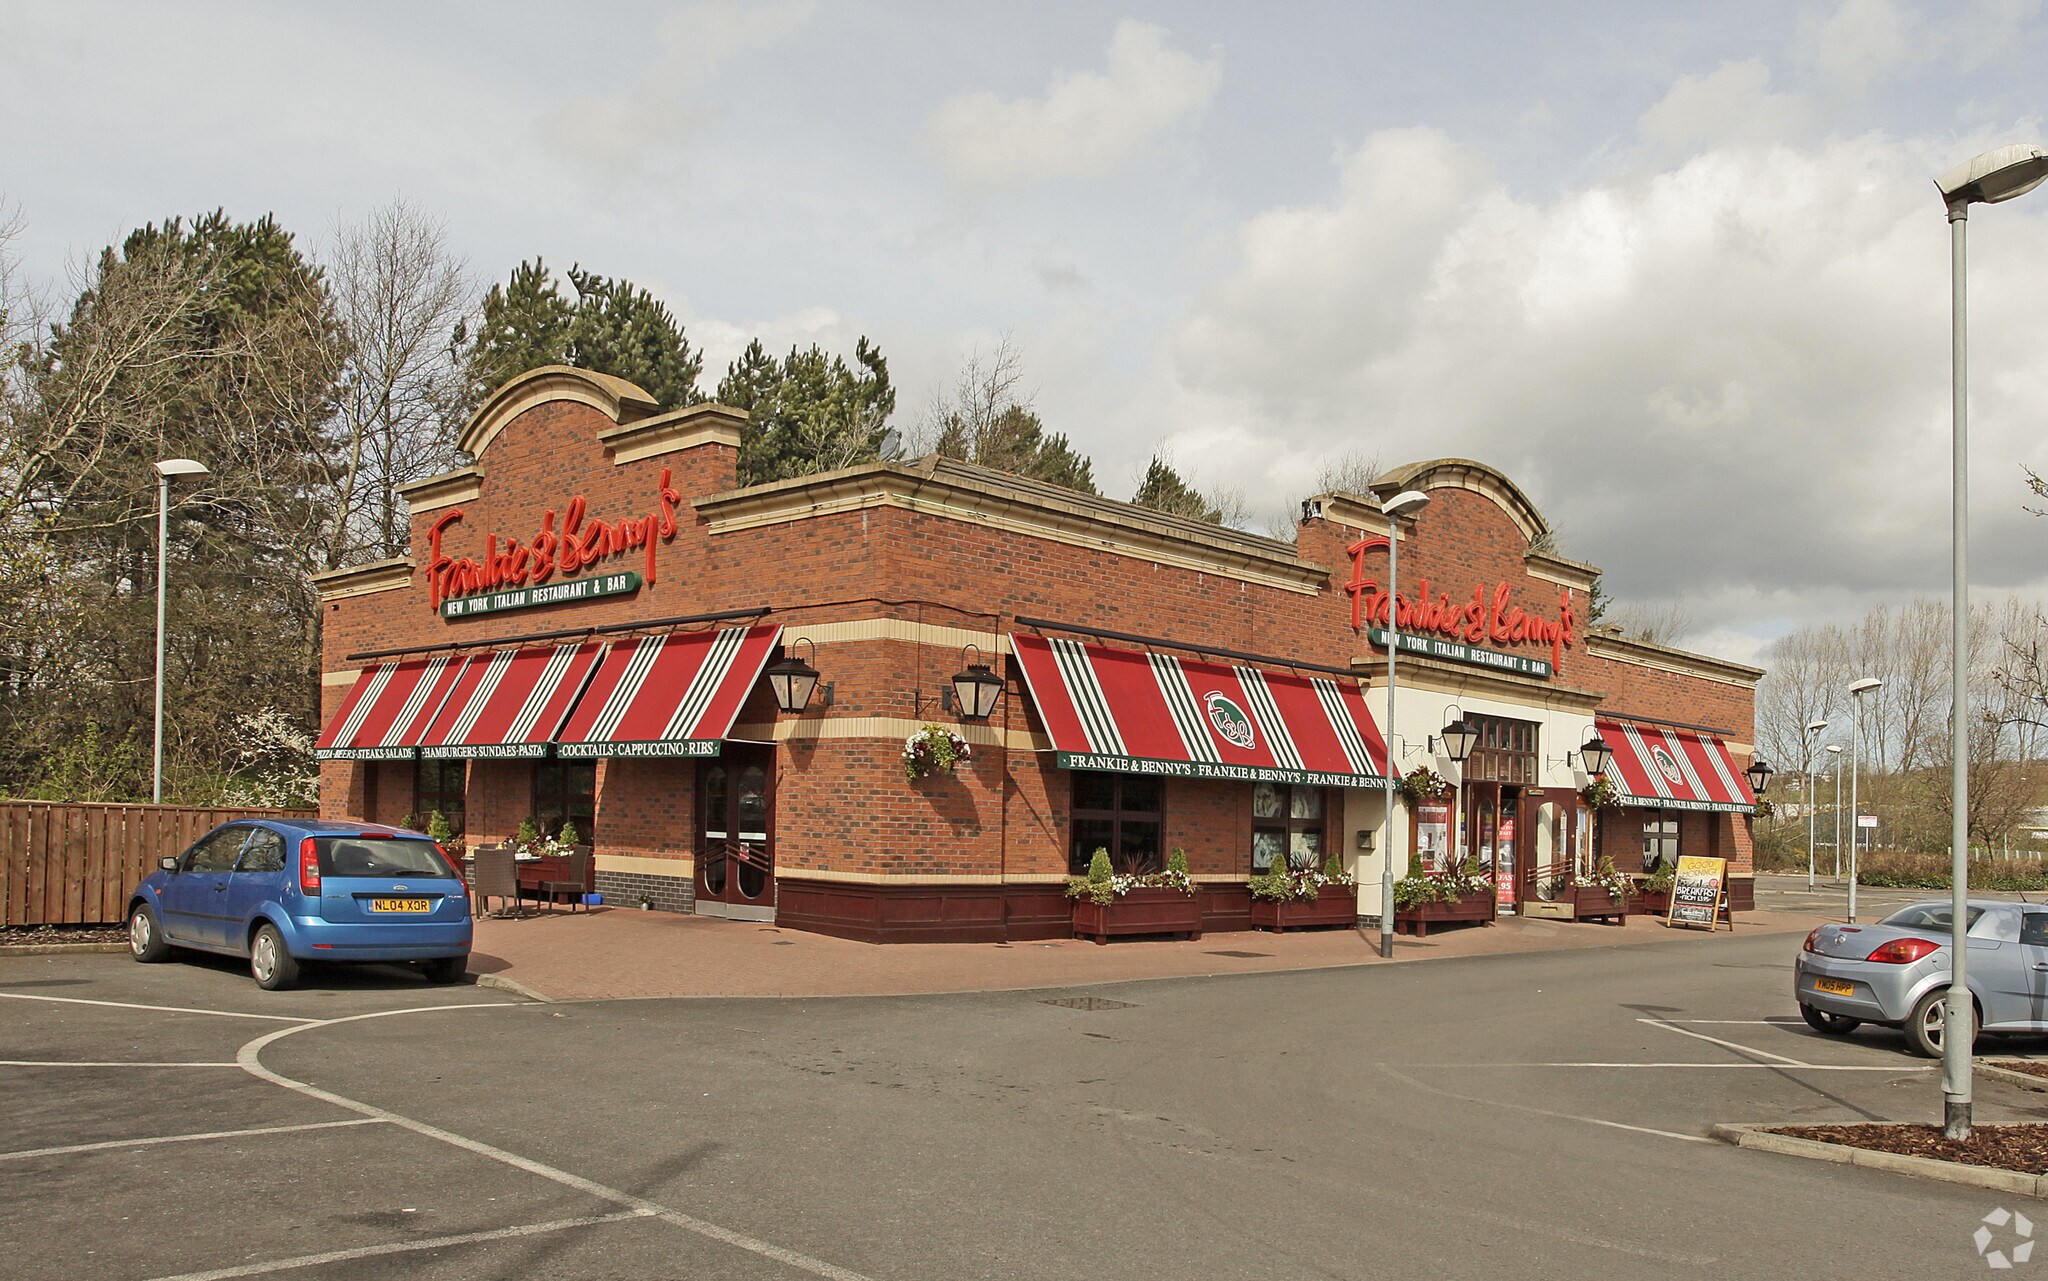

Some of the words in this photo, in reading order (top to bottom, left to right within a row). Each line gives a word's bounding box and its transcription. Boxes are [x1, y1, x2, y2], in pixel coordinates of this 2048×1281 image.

[424, 509, 530, 609] Frankie
[531, 510, 558, 583] &
[559, 467, 681, 583] Benny's
[447, 600, 464, 615] NEW
[468, 597, 489, 612] YORK
[494, 591, 526, 609] ITALIAN
[532, 580, 588, 603] RESTAURANT
[593, 579, 601, 593] &
[607, 575, 627, 592] BAR
[1344, 537, 1463, 637] Frankie
[1464, 583, 1488, 643] &
[1489, 581, 1574, 673] Benny's
[1406, 635, 1428, 652] YORK
[1434, 643, 1465, 659] ITALIAN
[1471, 649, 1518, 669] RESTAURANT
[1522, 660, 1528, 671] &
[1532, 661, 1546, 674] BAR
[1069, 755, 1129, 771] FRANKIE
[1131, 760, 1140, 772] &
[1141, 760, 1191, 775] BENNY'S
[1198, 764, 1249, 779] FRANKIE
[1250, 768, 1257, 780] &
[1258, 768, 1301, 783] BENNY'S
[1306, 772, 1350, 786] FRANKIE
[1351, 778, 1358, 787] &
[1688, 860, 1715, 870] GOOD
[375, 900, 403, 911] NL04
[1676, 886, 1717, 898] BREAKFAST
